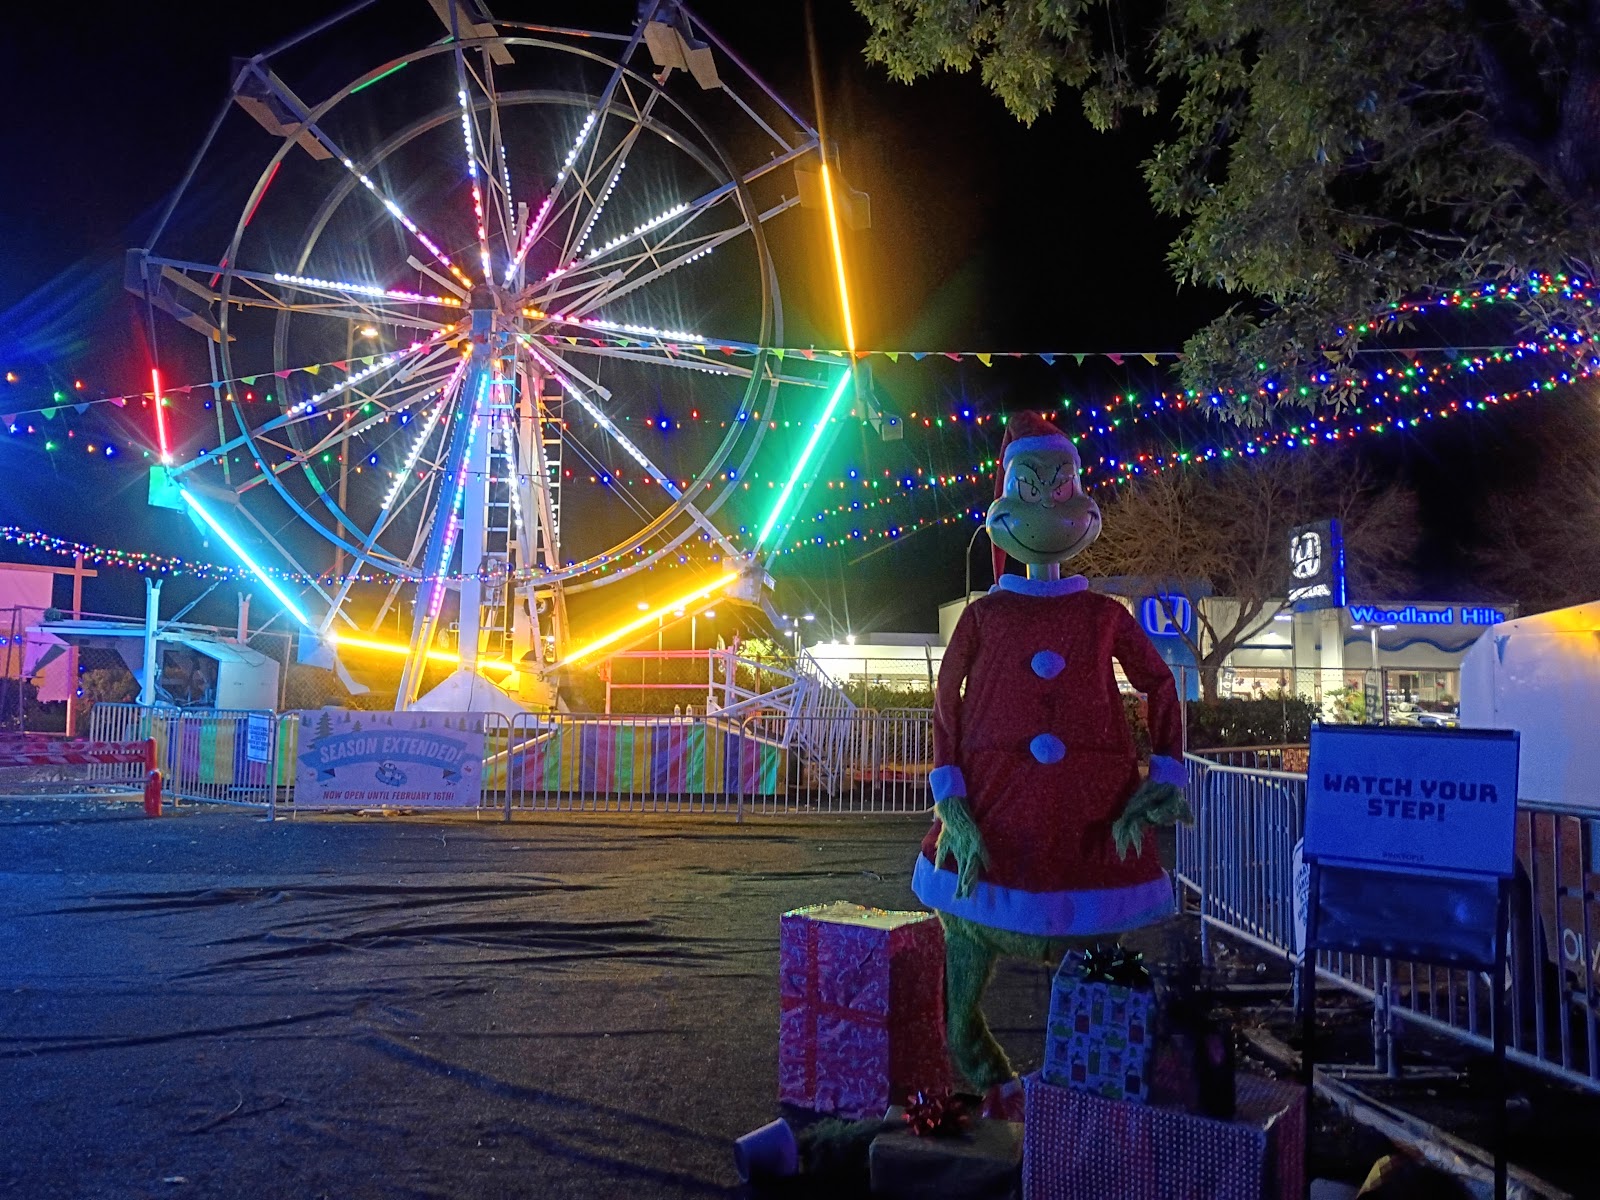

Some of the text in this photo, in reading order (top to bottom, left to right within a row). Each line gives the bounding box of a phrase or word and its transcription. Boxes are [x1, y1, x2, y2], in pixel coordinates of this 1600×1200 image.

[1350, 606, 1504, 624] Woodland Hills
[320, 736, 462, 764] SEASON EXTENDED!
[322, 790, 342, 800] NOW
[344, 790, 365, 800] OPEN
[367, 791, 389, 800] UNTIL
[391, 791, 431, 801] FEBRUARY
[1323, 773, 1498, 803] WATCH YOUR
[1367, 798, 1446, 822] STEP!
